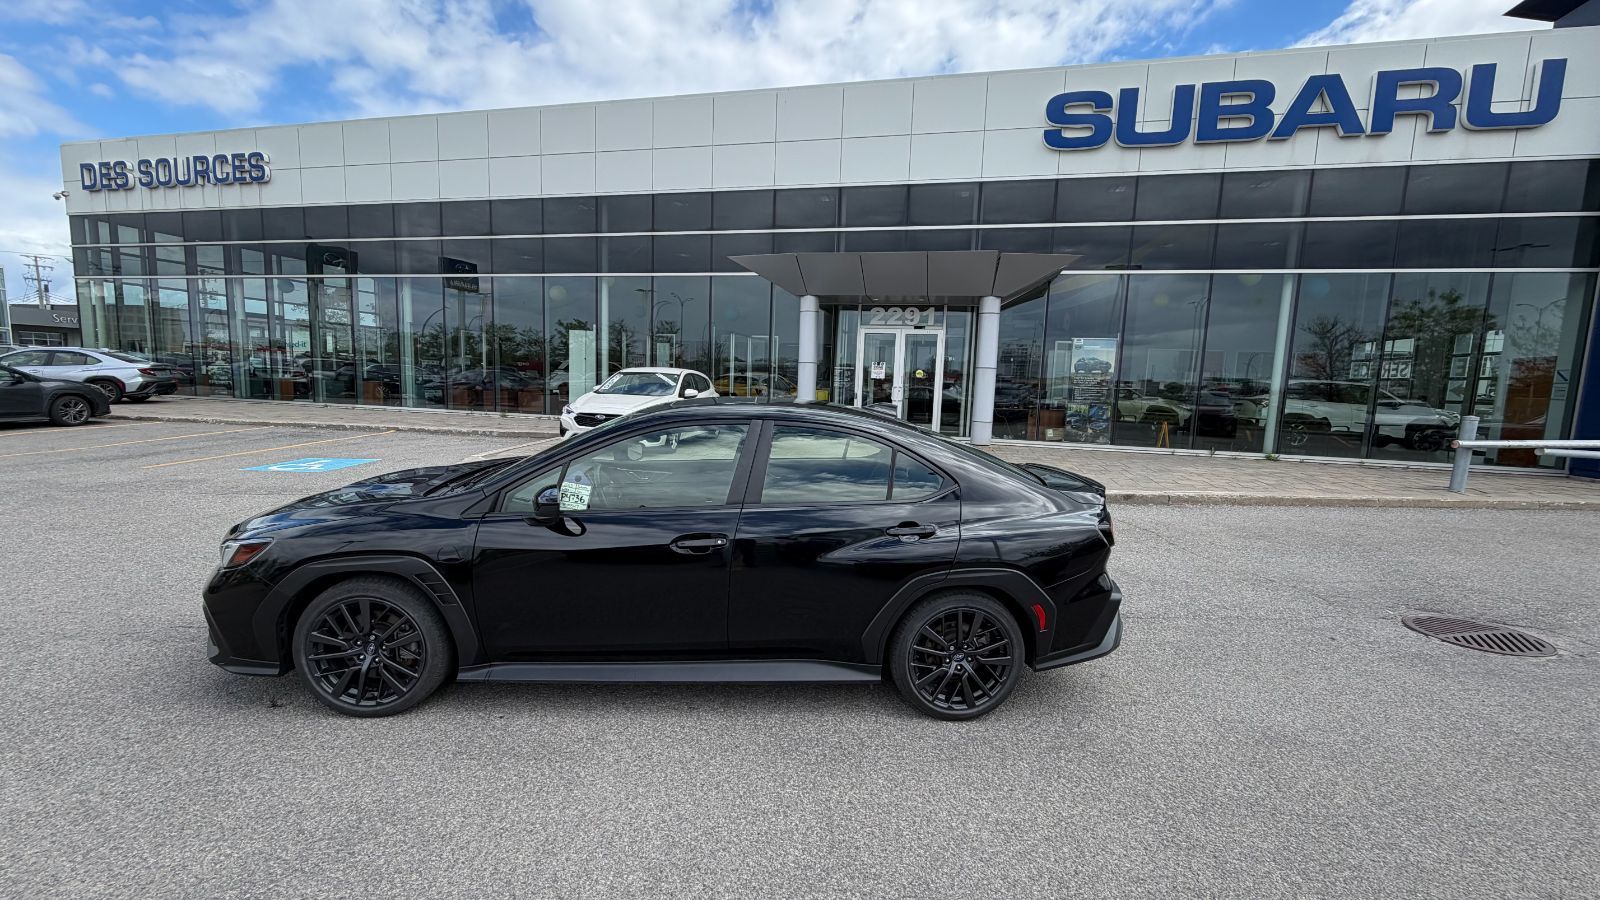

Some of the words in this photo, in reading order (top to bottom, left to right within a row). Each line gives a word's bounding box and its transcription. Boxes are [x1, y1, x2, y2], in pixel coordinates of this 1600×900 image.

[1043, 58, 1567, 150] SUBARU
[79, 160, 132, 191] DES
[138, 151, 269, 188] SOURCES
[53, 313, 78, 323] Serv
[869, 306, 935, 325] 2291
